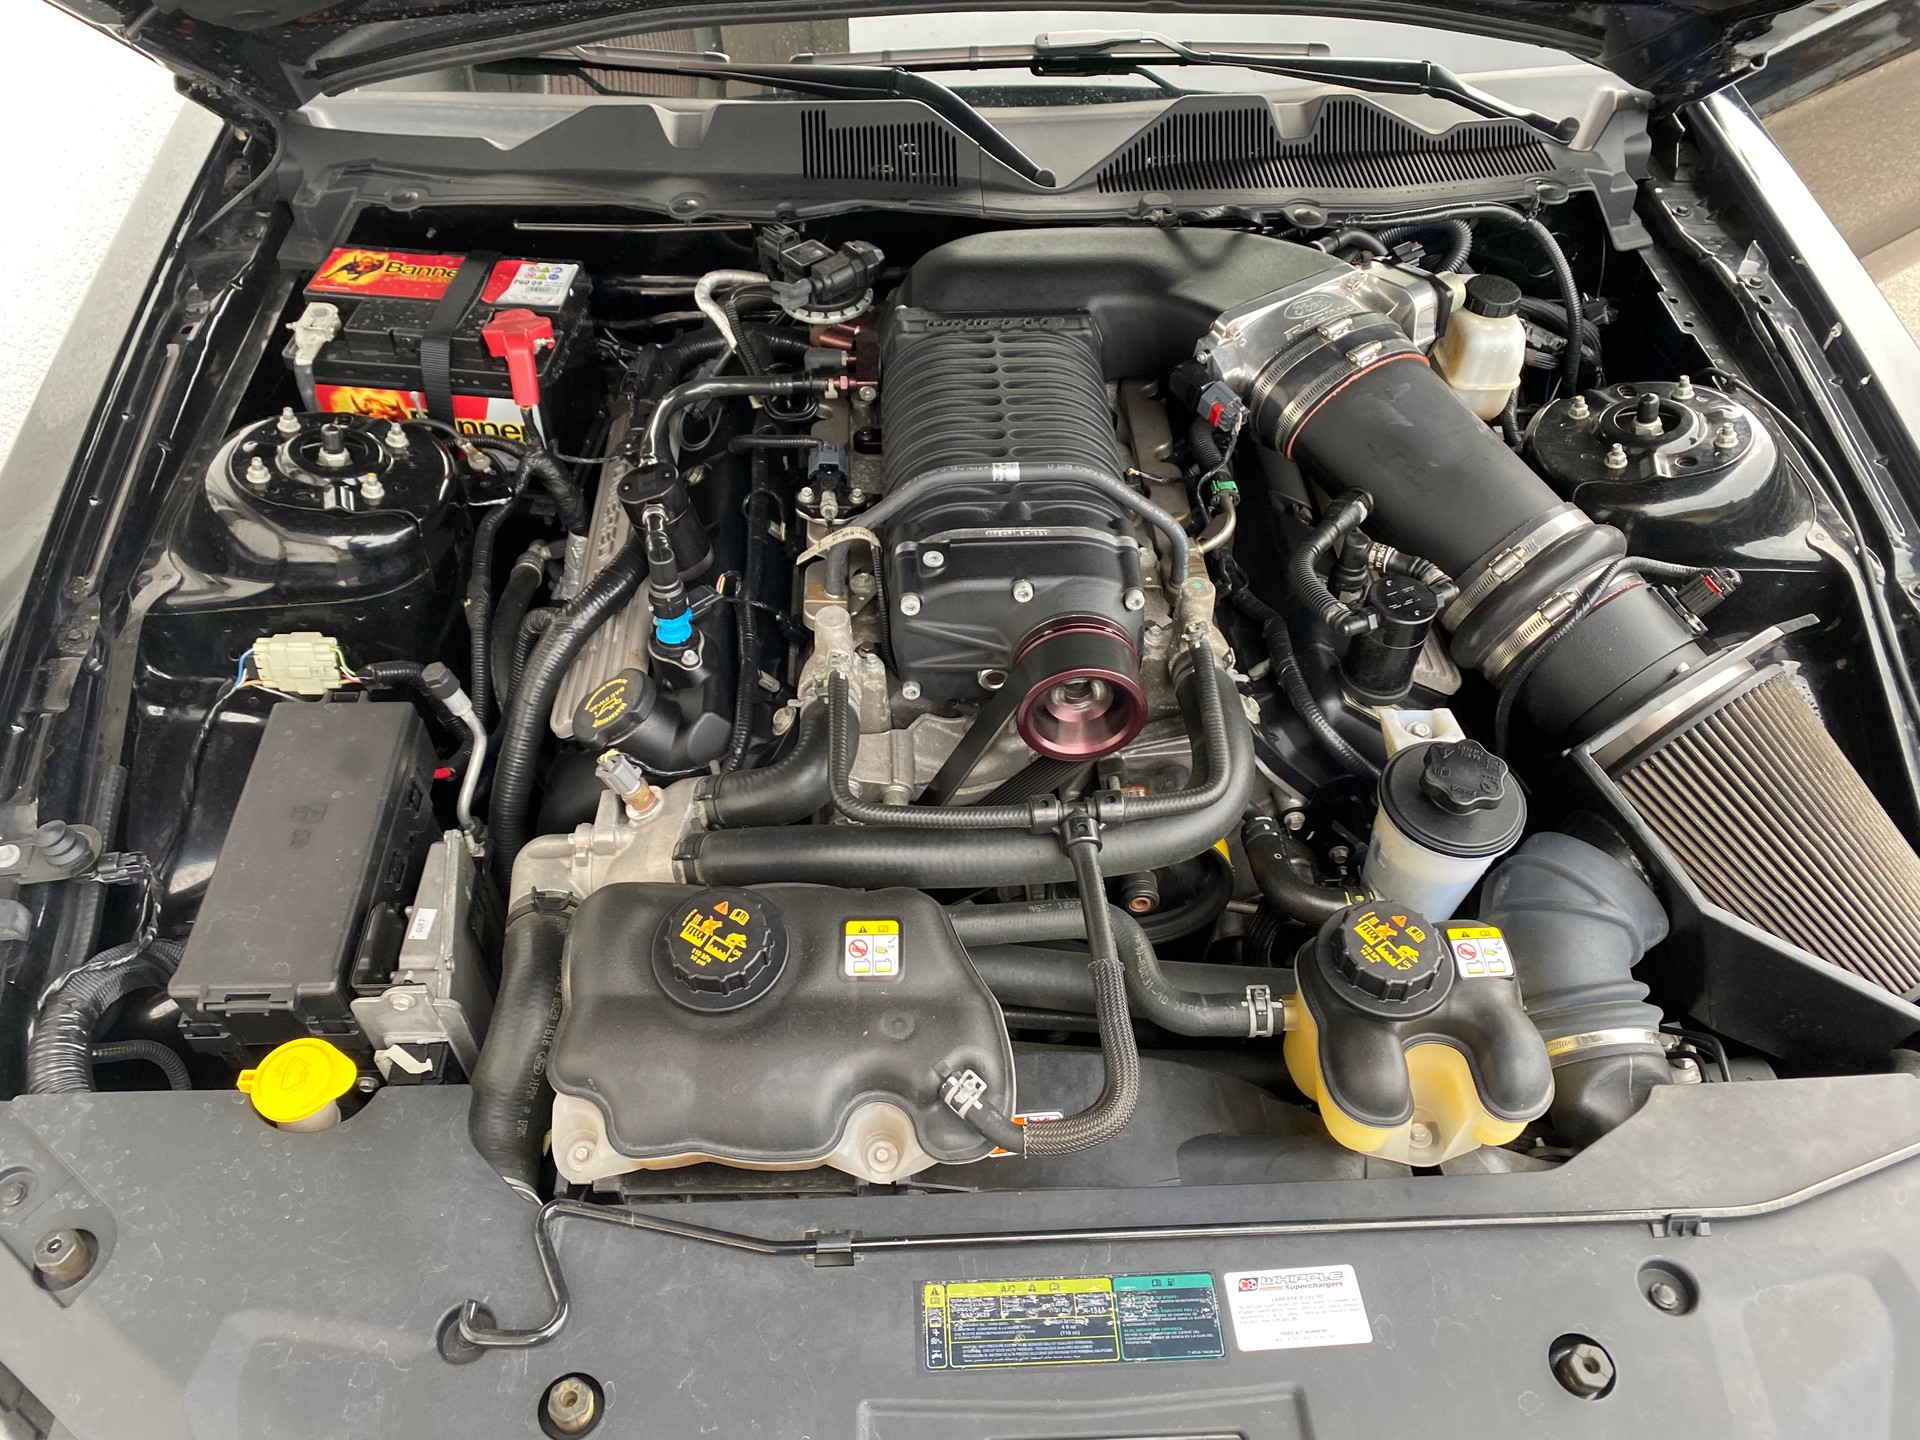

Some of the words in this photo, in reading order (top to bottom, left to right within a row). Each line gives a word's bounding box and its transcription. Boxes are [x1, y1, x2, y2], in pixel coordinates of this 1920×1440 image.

[384, 260, 459, 278] Banne
[1260, 1271, 1343, 1286] WHIPPLE
[1000, 1284, 1016, 1293] A/C
[1285, 1281, 1344, 1291] Superchargers
